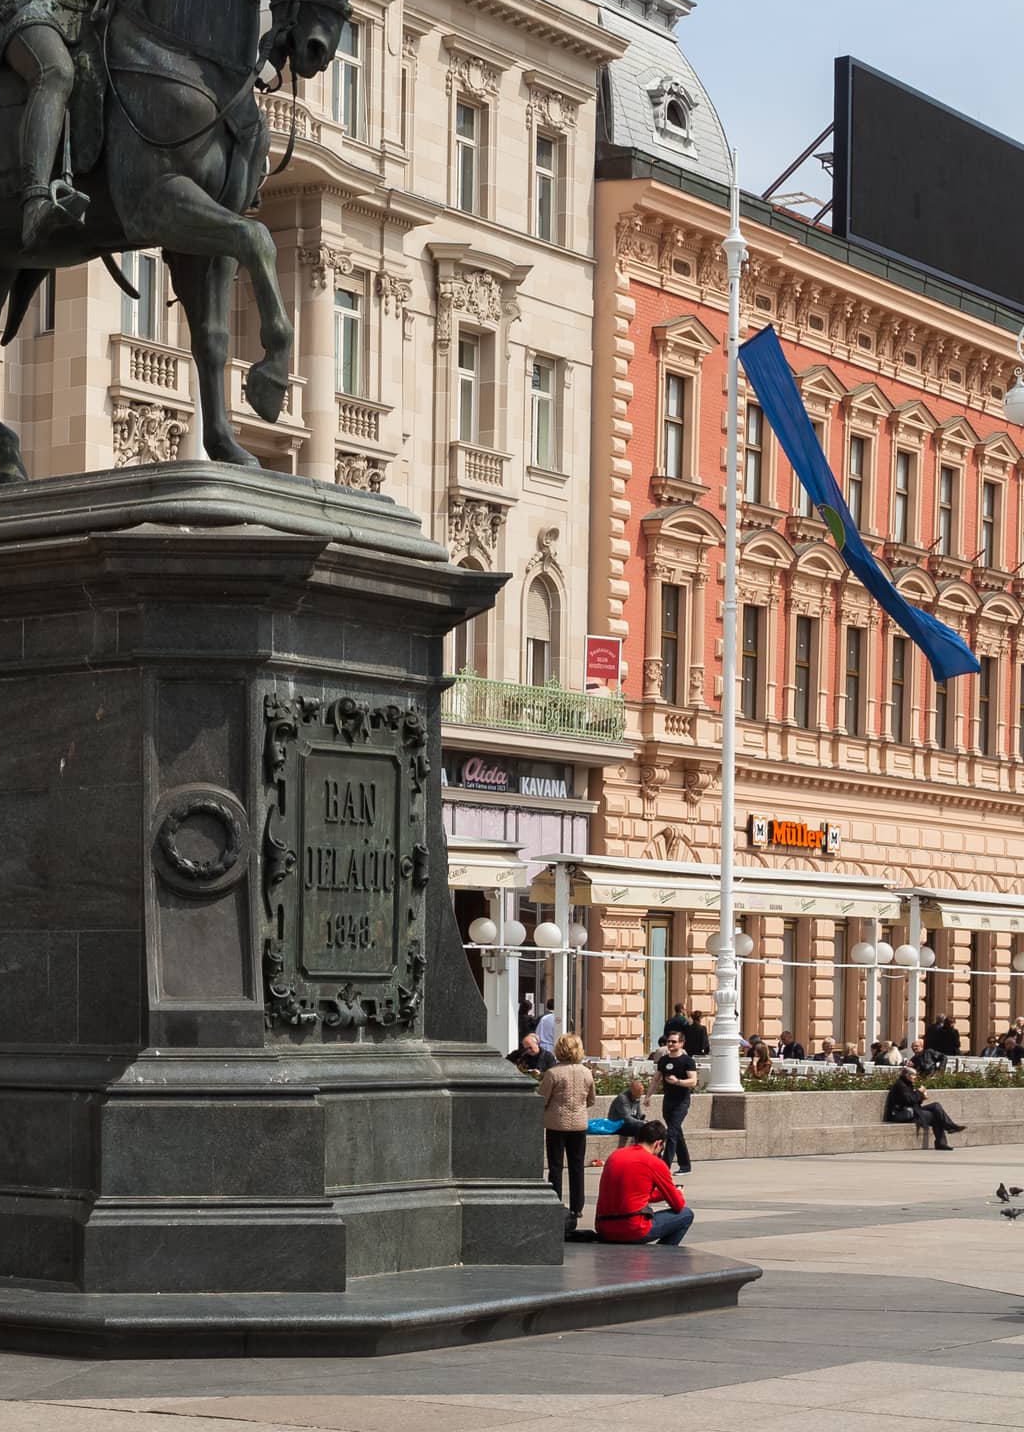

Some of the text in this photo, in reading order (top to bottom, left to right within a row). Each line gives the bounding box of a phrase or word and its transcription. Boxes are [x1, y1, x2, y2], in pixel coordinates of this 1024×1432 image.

[325, 778, 376, 825] BAN
[521, 776, 568, 799] KAVANA
[772, 819, 824, 848] Müller
